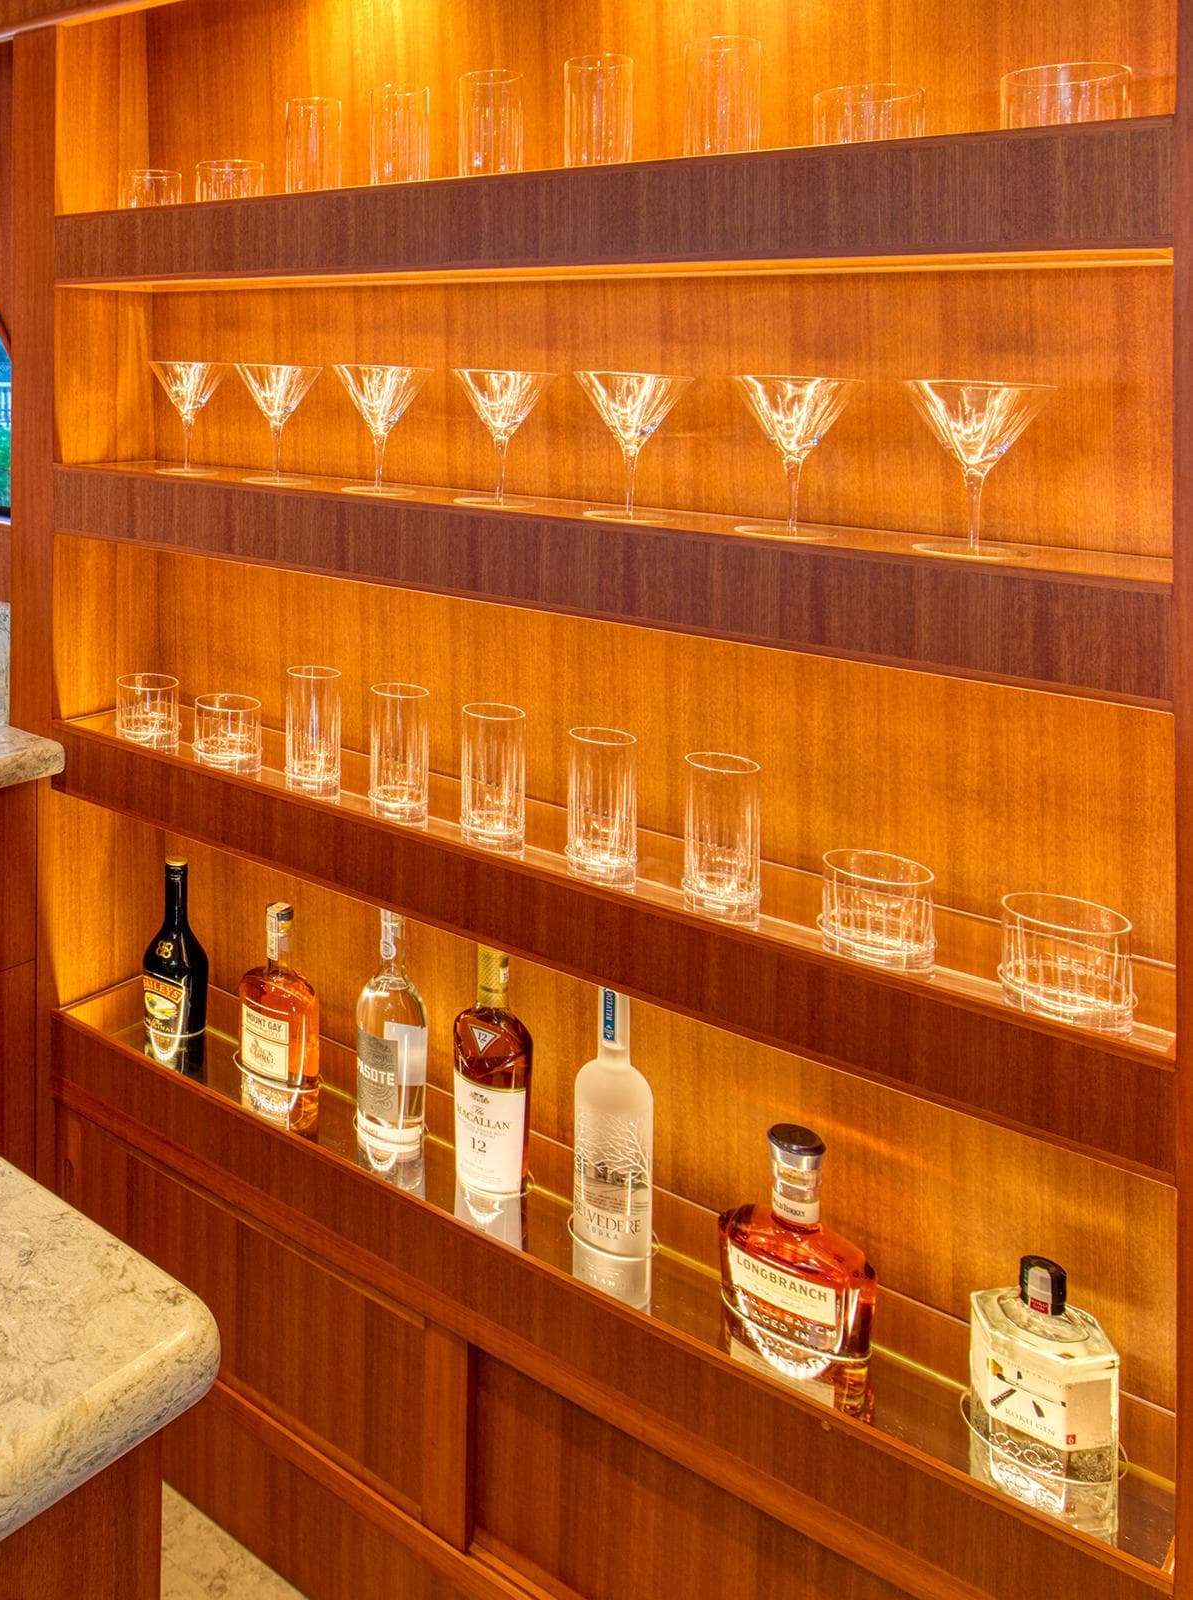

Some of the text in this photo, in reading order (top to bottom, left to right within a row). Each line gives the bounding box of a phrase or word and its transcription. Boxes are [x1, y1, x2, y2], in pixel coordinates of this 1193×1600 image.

[246, 1010, 266, 1028] MOUNT
[267, 1021, 282, 1033] GAY
[477, 1031, 489, 1042] 12
[456, 1102, 511, 1131] MACALLAN
[470, 1136, 487, 1154] 12
[574, 1201, 642, 1236] BELVEDERE
[736, 1254, 828, 1302] LONGBRANCH
